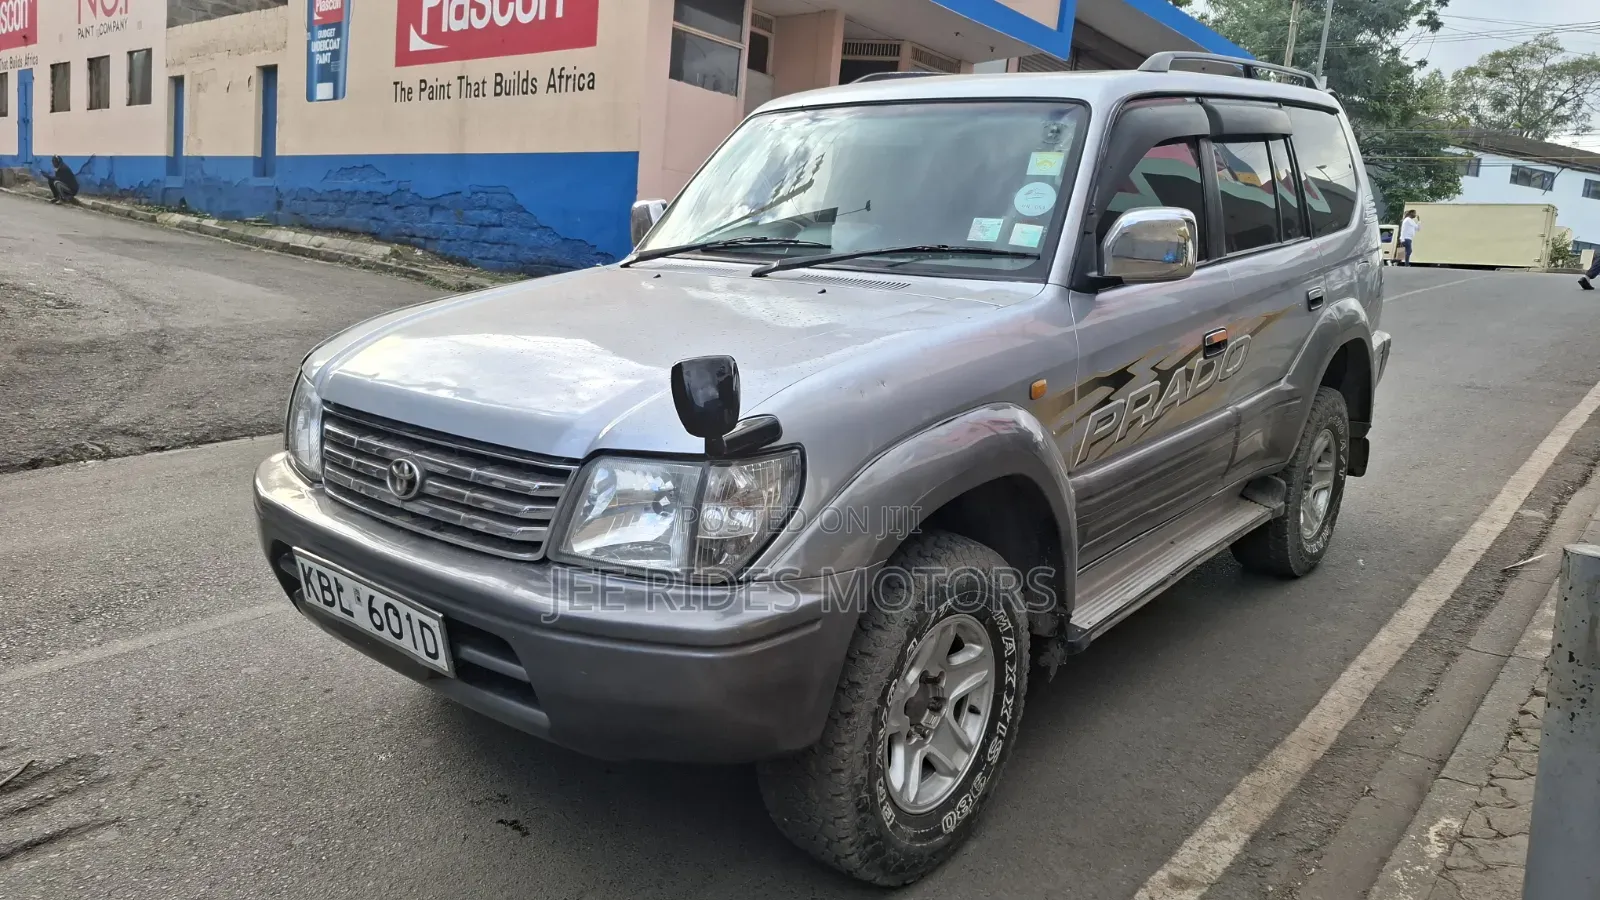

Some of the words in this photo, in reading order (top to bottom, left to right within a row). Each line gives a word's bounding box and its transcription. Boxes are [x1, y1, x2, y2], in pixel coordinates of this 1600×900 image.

[0, 0, 28, 34] scon
[78, 25, 94, 39] PAINT
[100, 18, 128, 36] COMPANY
[318, 28, 336, 39] BUDGET
[421, 0, 564, 35] Plascon
[24, 52, 38, 67] Africa
[311, 38, 341, 52] UNDERCOAT
[316, 52, 331, 64] PAINT
[393, 80, 413, 103] The
[418, 78, 452, 101] Paint
[457, 75, 487, 99] That
[493, 69, 538, 97] Builds
[545, 65, 596, 94] Africa
[1073, 334, 1251, 468] PRADO
[301, 562, 354, 618] KBL
[367, 594, 439, 661] 601D
[987, 608, 1017, 765] MAXXIS
